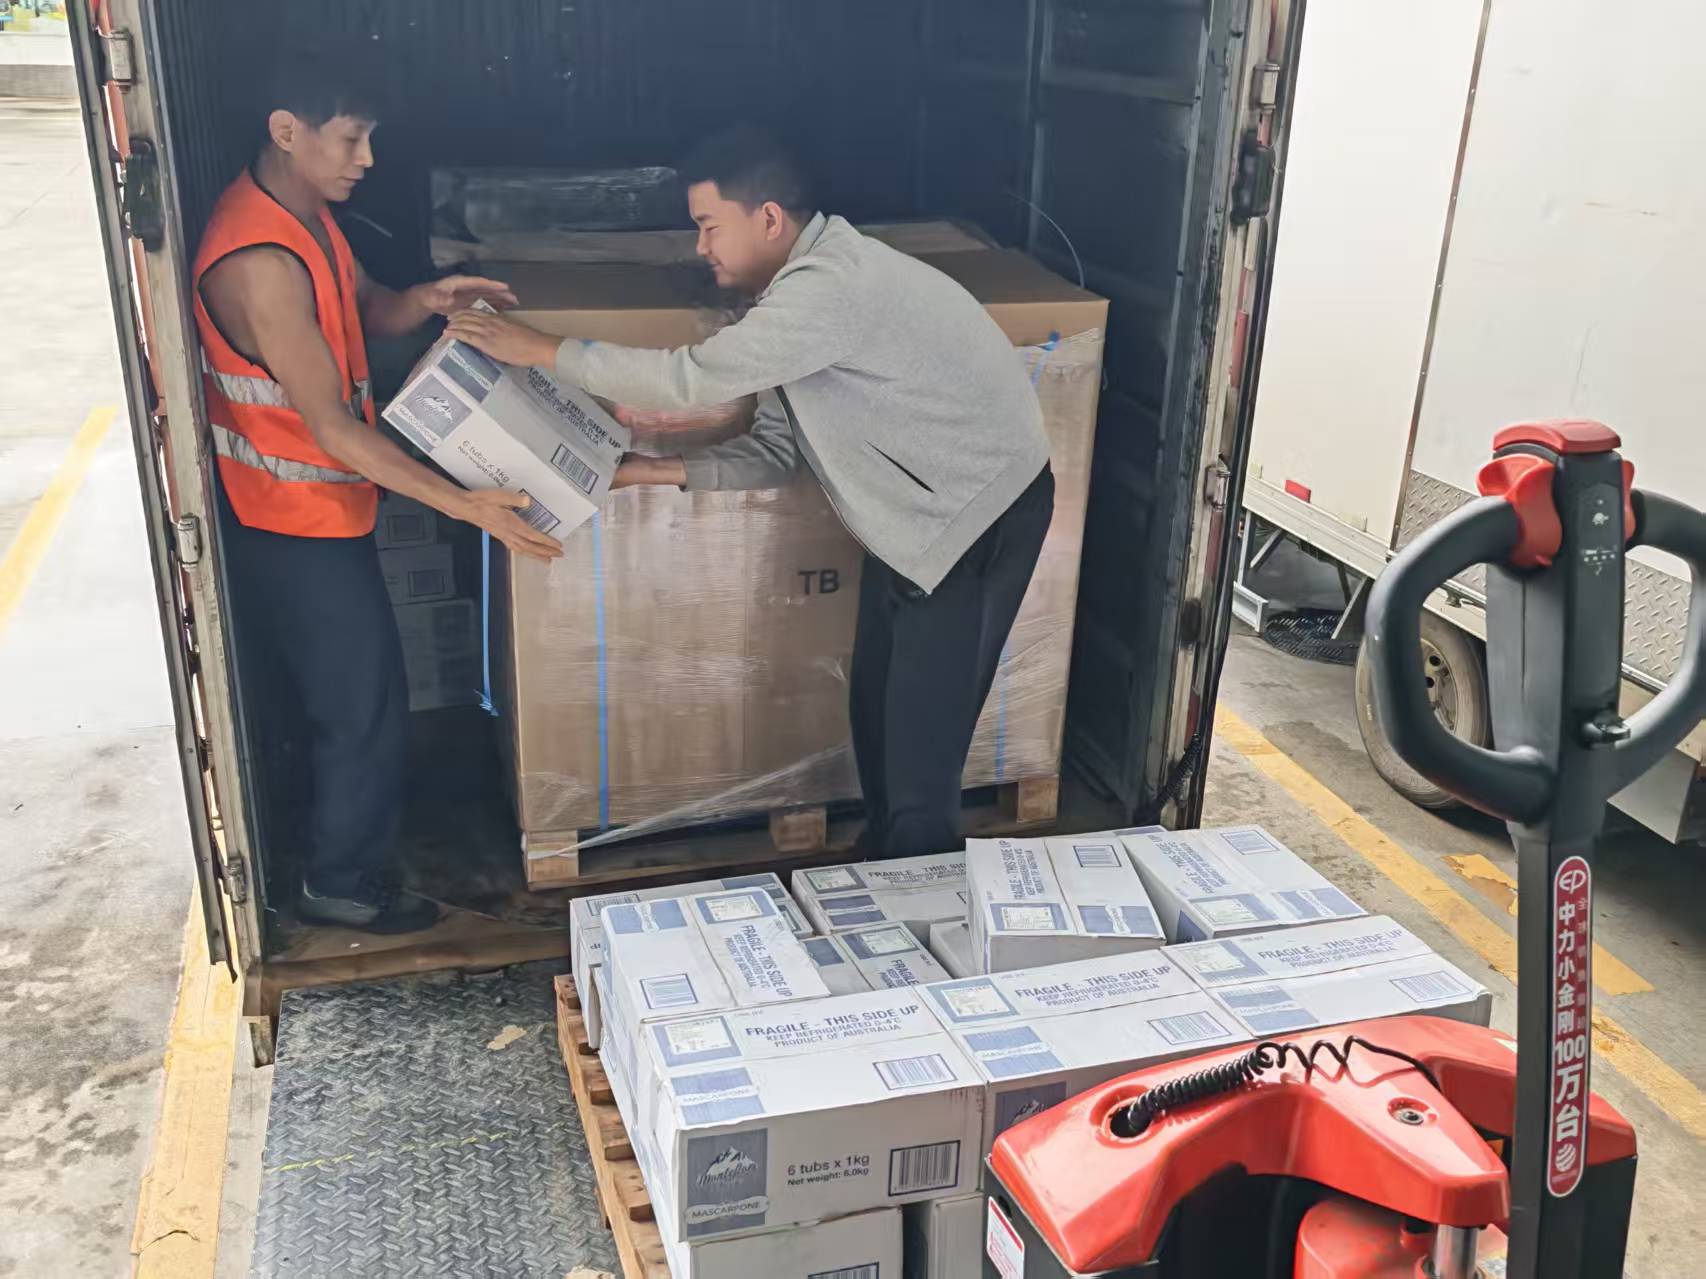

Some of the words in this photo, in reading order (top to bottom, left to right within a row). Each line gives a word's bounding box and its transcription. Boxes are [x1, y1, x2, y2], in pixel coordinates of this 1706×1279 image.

[526, 366, 558, 394] AGILE
[585, 418, 608, 438] SIDE
[607, 437, 621, 449] UP
[797, 569, 840, 595] TB
[868, 869, 913, 878] FRAGILE
[743, 925, 767, 951] FRAGILE
[1257, 944, 1311, 960] FRAGILE
[1325, 940, 1356, 951] THIS
[1356, 933, 1386, 944] SIDE
[1386, 929, 1403, 939] UP
[761, 955, 777, 970] THIS
[767, 970, 787, 988] SIDE
[1015, 982, 1073, 998] FRAGILE
[1086, 974, 1118, 986] THIS
[1118, 970, 1151, 981] SIDE
[1153, 965, 1171, 976] UP
[776, 986, 792, 997] UP
[745, 1021, 808, 1036] FRAGILE
[824, 1013, 859, 1026] THIS
[862, 1008, 896, 1021] SIDE
[900, 1004, 919, 1015] UP
[795, 1020, 872, 1039] REFRIGERATED
[774, 1035, 822, 1048] PRODUCT
[826, 1033, 838, 1041] OF
[843, 1023, 901, 1037] AUSTRALIA
[788, 1165, 796, 1176] 6
[800, 1160, 829, 1175] tubs
[834, 1160, 841, 1168] x
[845, 1154, 870, 1167] 1kg
[788, 1177, 803, 1187] Net
[807, 1173, 841, 1185] weight:
[691, 1201, 760, 1218] MASCARPONE
